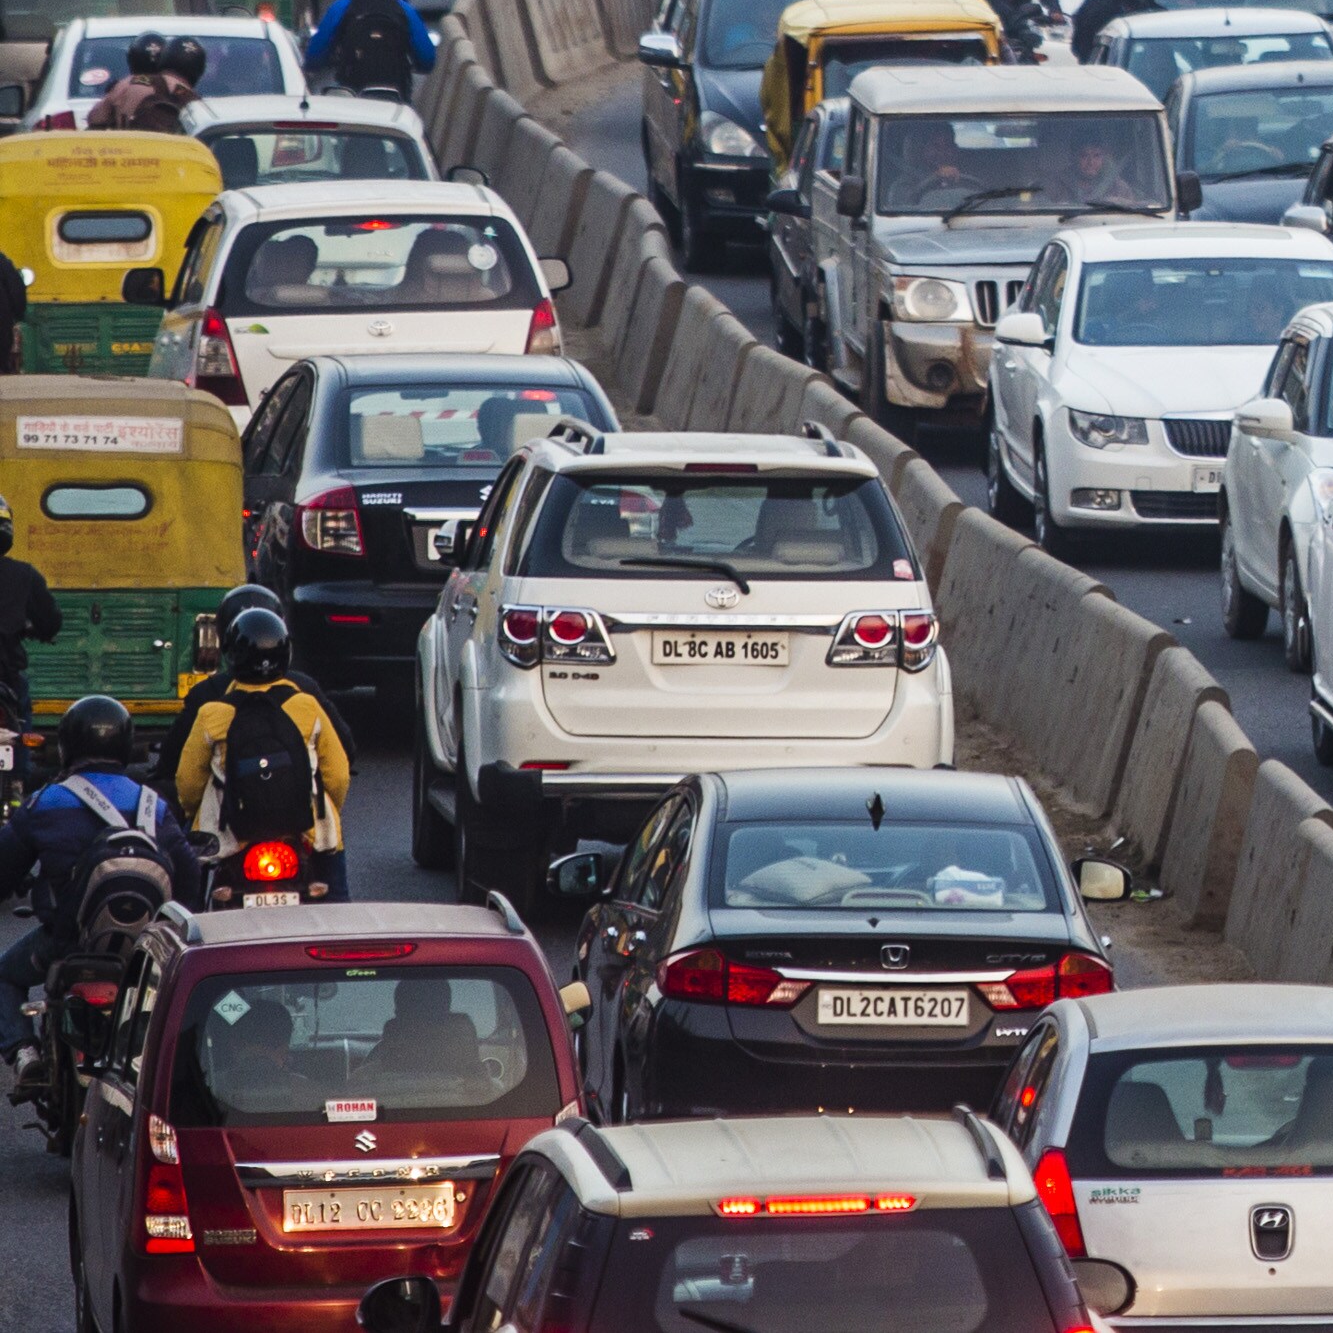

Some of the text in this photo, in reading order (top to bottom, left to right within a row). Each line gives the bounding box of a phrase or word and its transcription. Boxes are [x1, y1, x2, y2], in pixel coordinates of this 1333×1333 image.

[23, 434, 119, 446] 99 71 73 71 74
[662, 640, 780, 660] DL 8C AB 1605
[255, 894, 288, 907] DL3S
[220, 1003, 244, 1013] CNG
[832, 995, 966, 1019] DL2CAT6207
[336, 1102, 375, 1113] ROHAN
[1091, 1187, 1141, 1197] sikka
[291, 1202, 341, 1225] DL12
[356, 1200, 383, 1222] CC
